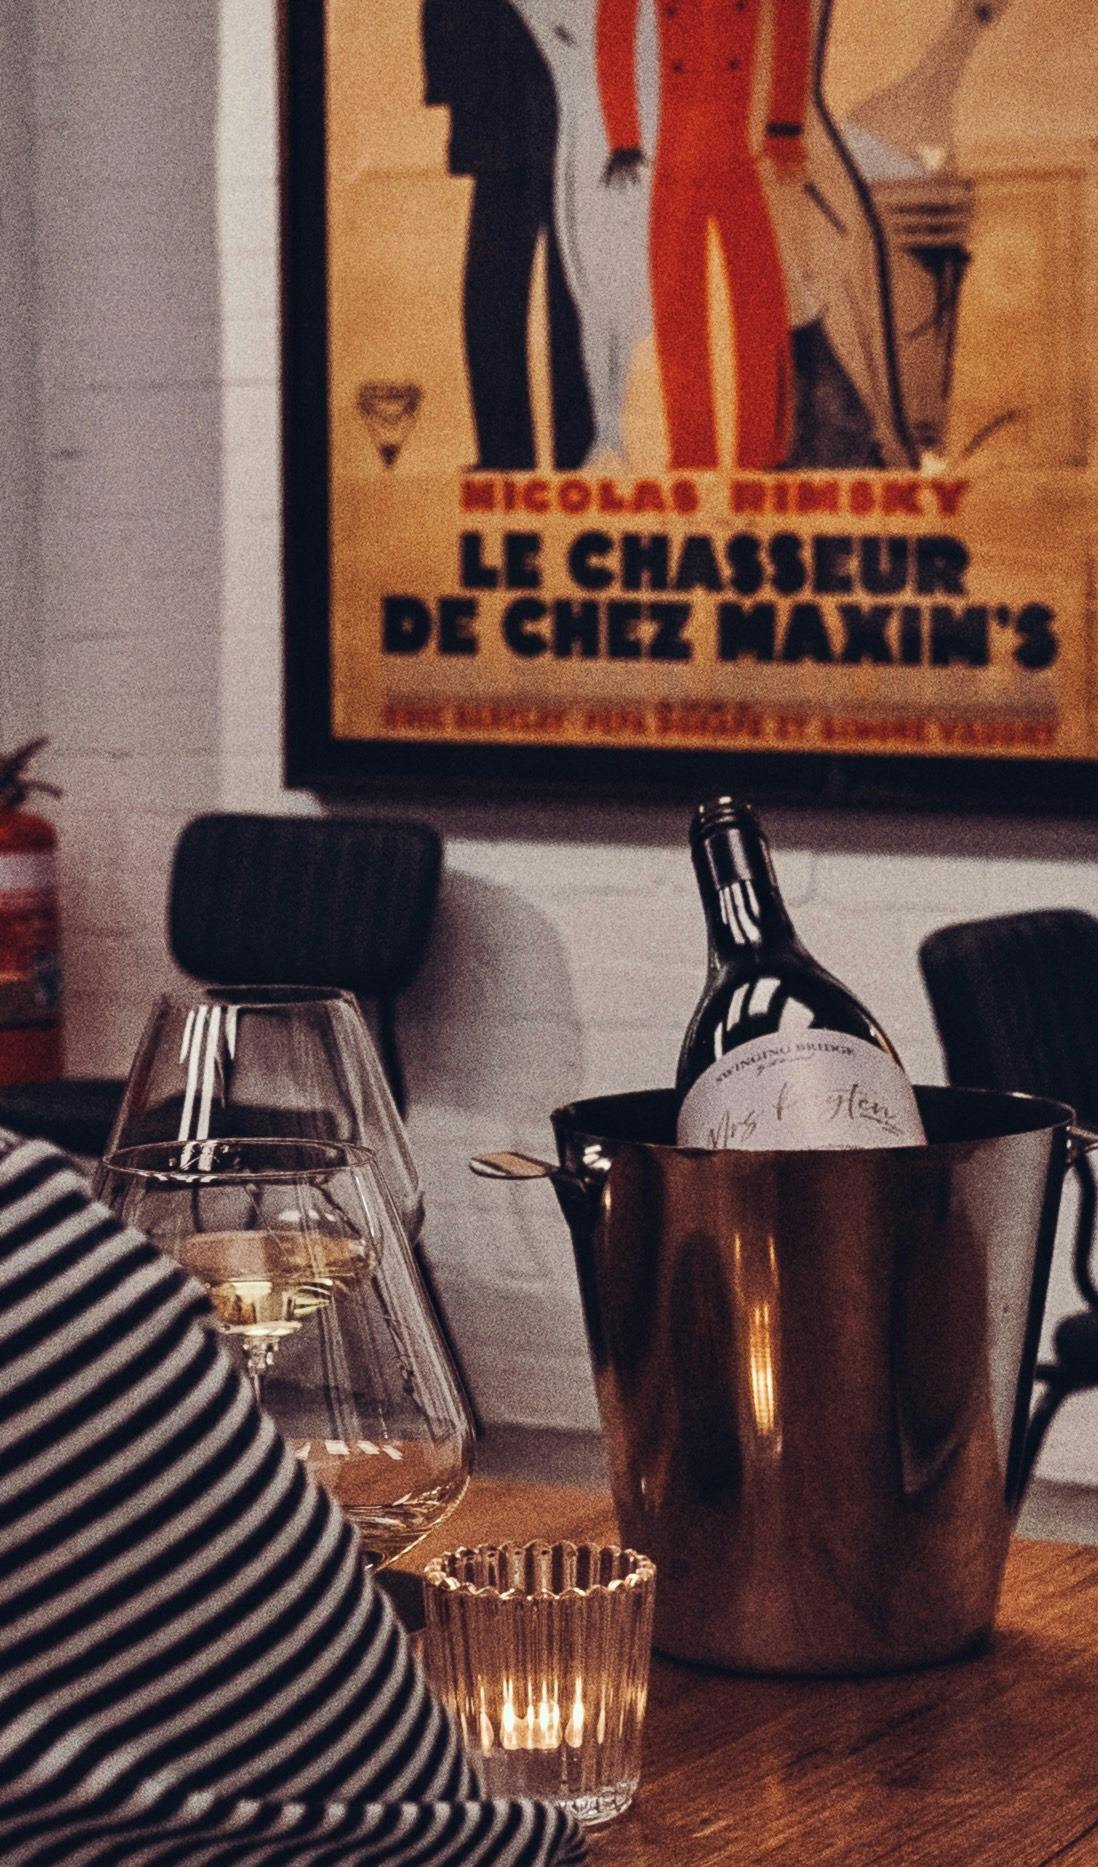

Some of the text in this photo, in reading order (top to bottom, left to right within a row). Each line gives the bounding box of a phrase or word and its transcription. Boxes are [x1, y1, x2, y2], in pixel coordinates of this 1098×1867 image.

[460, 480, 969, 518] NICOLAS RIMSKY
[459, 532, 969, 596] LE CHASSEUR
[381, 597, 1058, 671] DE CHEZ MAXIM'S
[715, 1045, 792, 1083] SWINGING
[795, 1042, 855, 1057] BRIDGE
